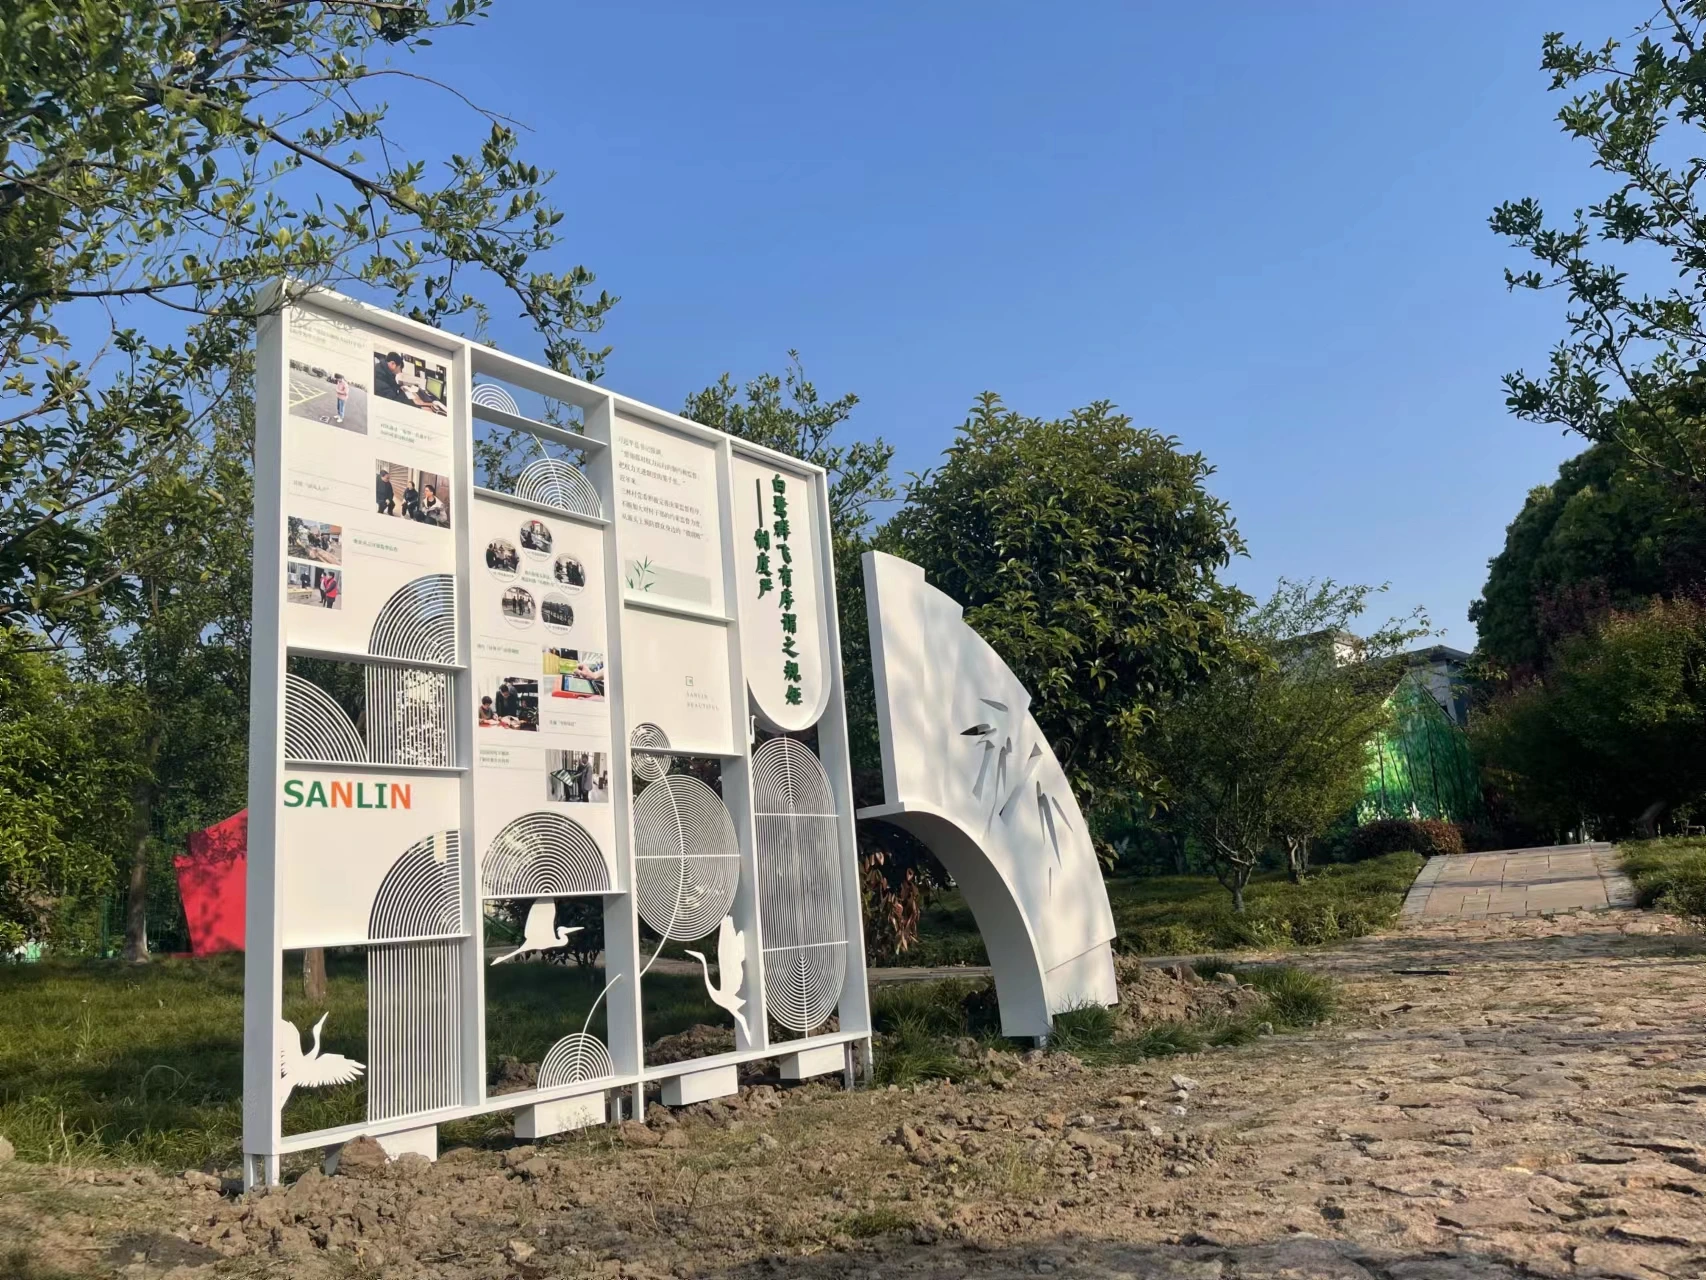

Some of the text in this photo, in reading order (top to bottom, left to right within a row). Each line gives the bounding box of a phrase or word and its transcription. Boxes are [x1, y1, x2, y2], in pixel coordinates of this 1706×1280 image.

[772, 473, 803, 705] 白鹭群飞有序谓之规矩
[283, 779, 411, 810] SANLIN
